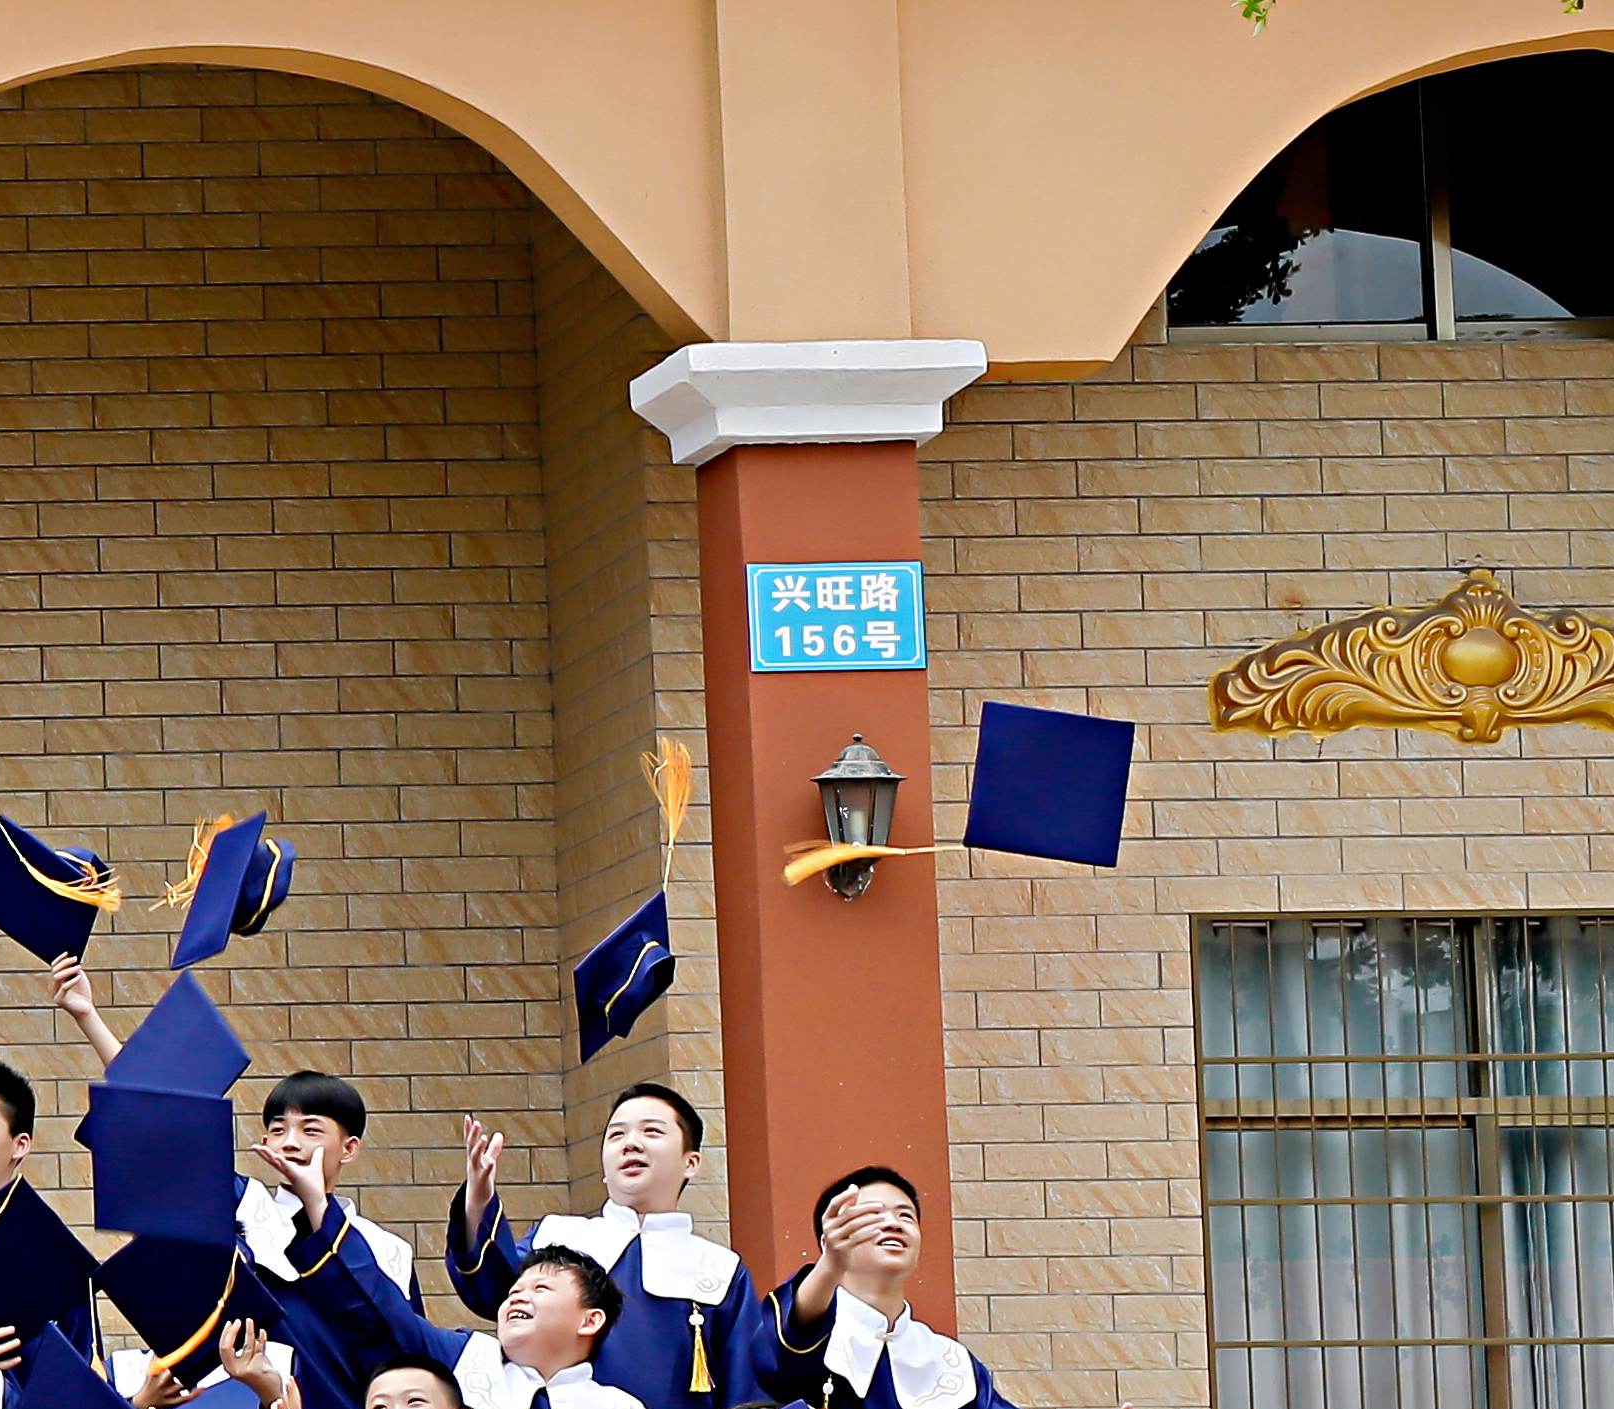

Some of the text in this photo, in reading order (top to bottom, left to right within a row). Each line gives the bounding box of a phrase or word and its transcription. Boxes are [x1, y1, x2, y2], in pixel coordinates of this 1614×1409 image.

[771, 573, 900, 613] 兴旺路
[774, 620, 901, 659] 156号
